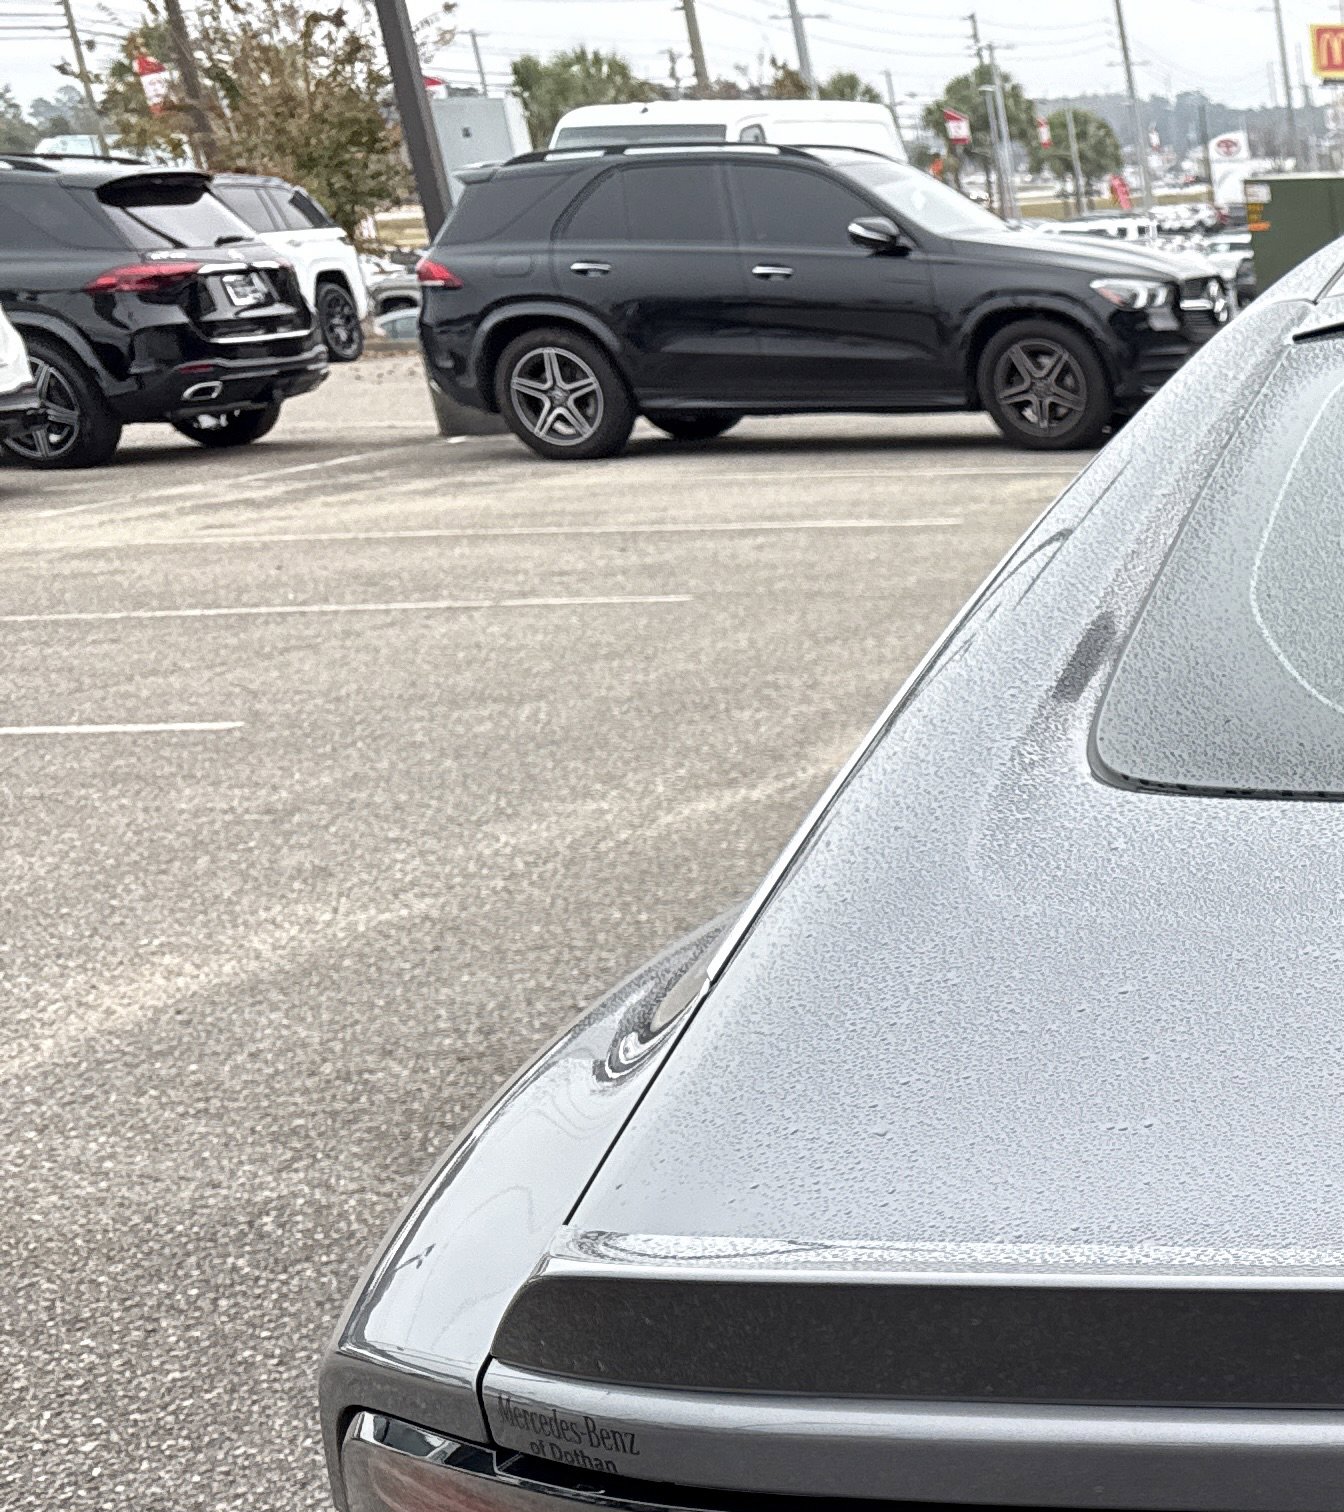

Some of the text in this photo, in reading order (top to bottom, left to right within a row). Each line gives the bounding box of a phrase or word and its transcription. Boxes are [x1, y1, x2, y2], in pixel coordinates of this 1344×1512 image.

[497, 1395, 640, 1456] Mercedes-Benz
[530, 1439, 618, 1473] of Dothan
